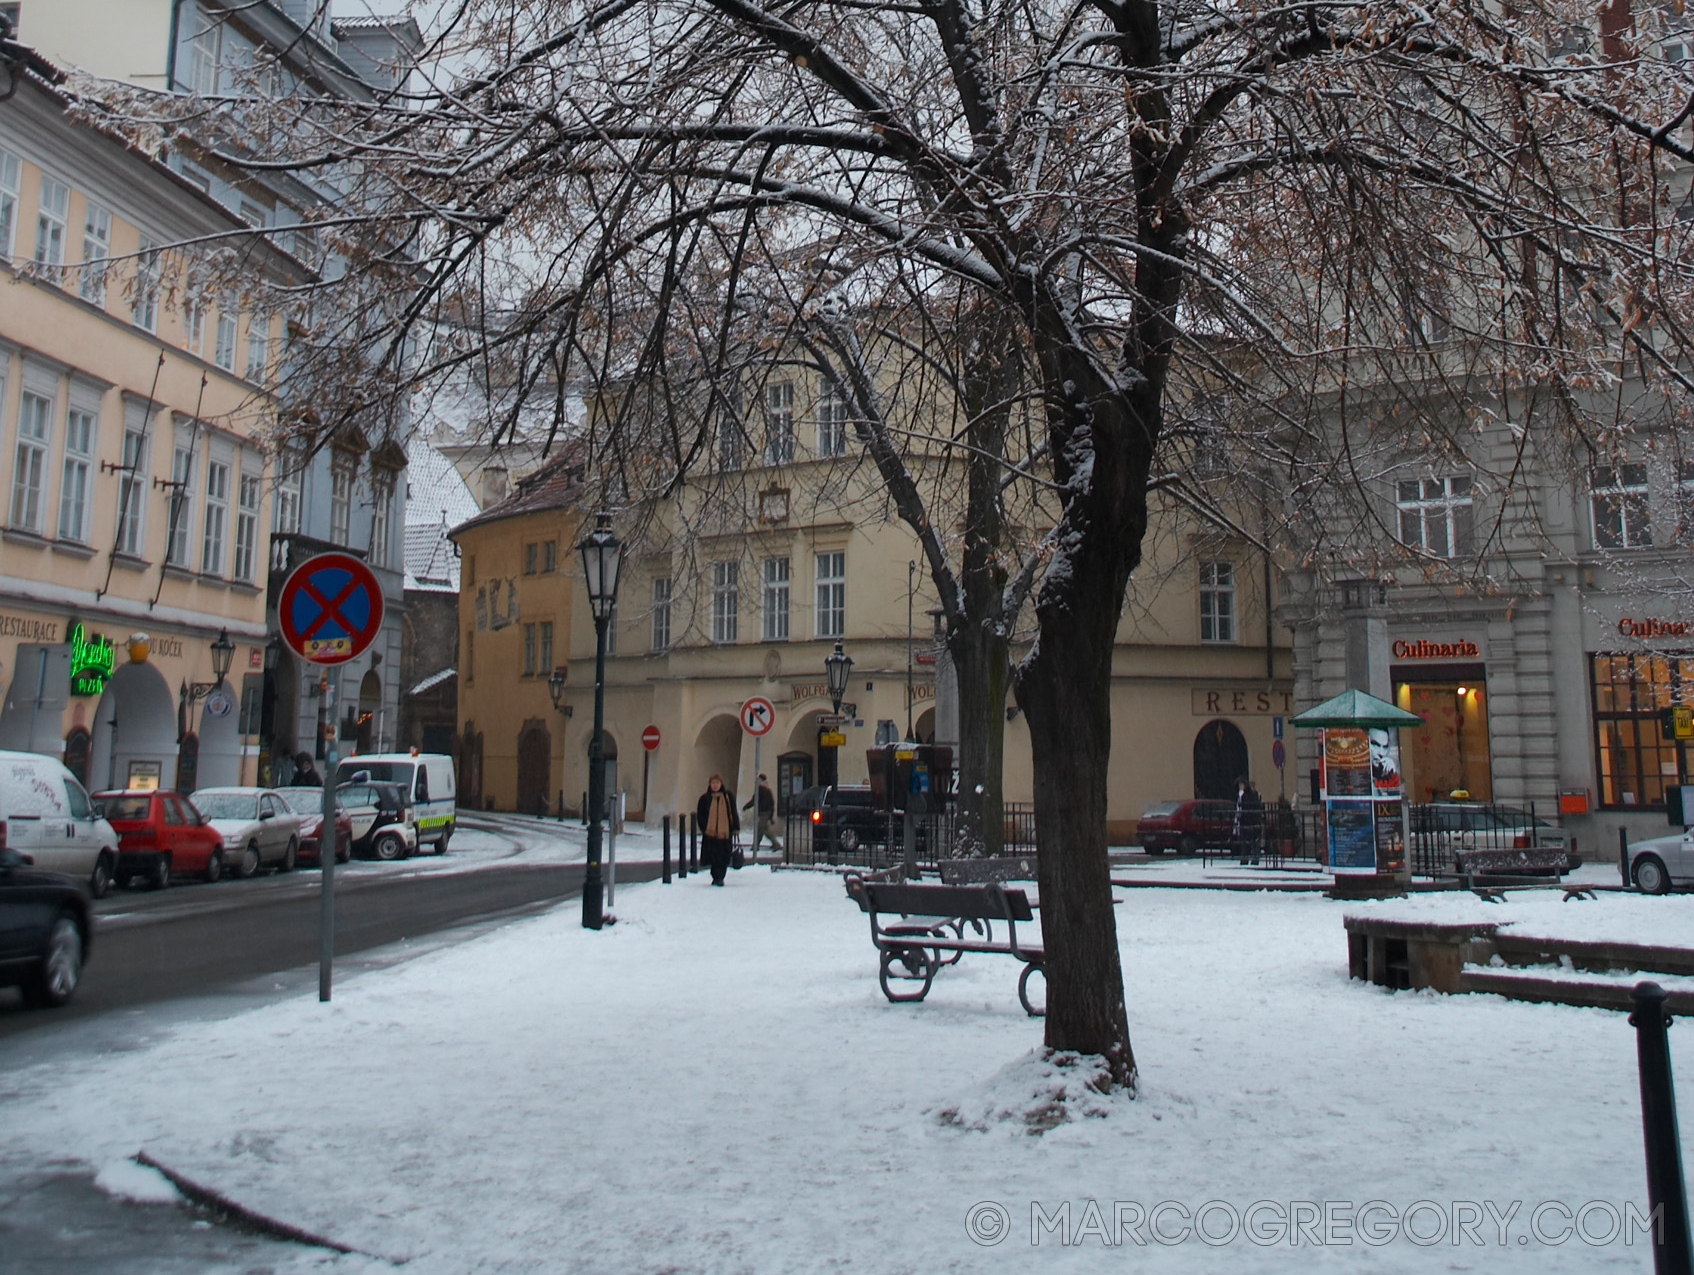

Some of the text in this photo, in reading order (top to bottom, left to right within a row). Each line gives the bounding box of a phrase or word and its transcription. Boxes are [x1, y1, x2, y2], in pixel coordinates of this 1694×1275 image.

[158, 636, 184, 659] KOČEK
[1392, 638, 1480, 659] Culinaria
[793, 684, 830, 700] WOLFGA
